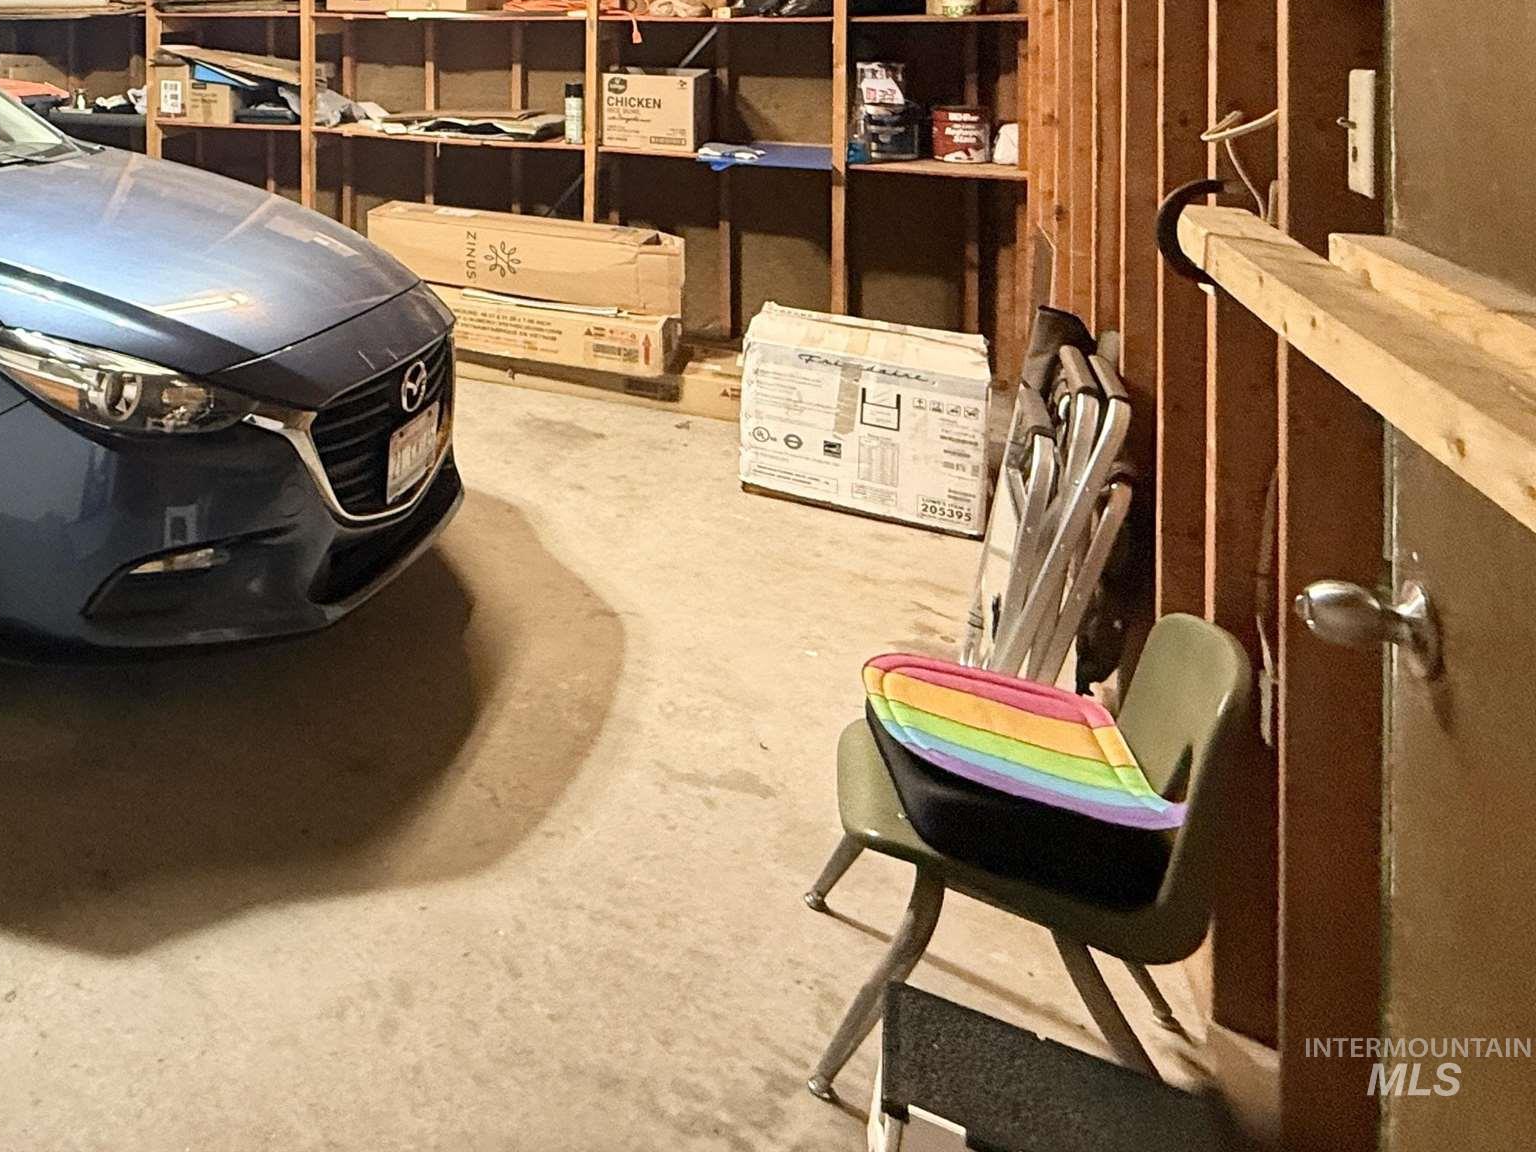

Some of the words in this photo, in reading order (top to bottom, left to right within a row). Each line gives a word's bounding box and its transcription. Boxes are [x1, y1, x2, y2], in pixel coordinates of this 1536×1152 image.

[606, 96, 662, 109] CHICKEN
[466, 231, 477, 279] ZINUS
[921, 503, 972, 522] 205395
